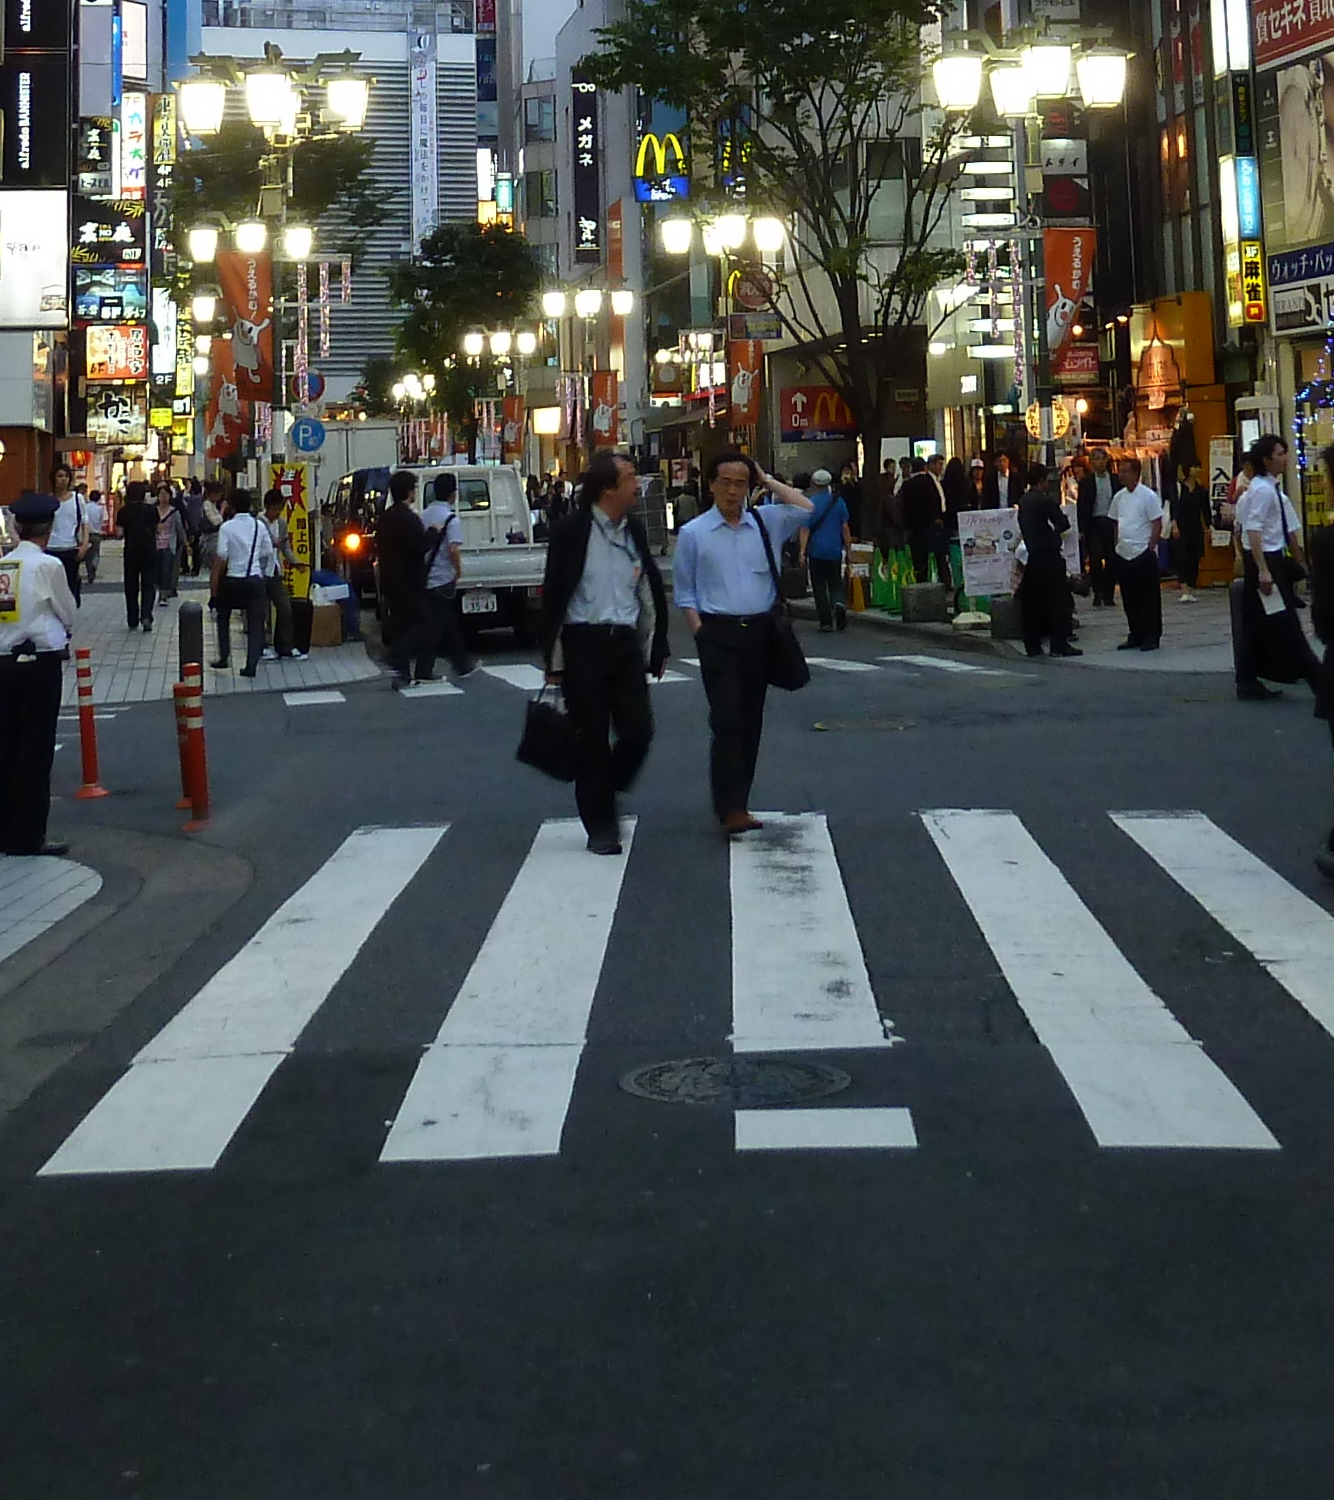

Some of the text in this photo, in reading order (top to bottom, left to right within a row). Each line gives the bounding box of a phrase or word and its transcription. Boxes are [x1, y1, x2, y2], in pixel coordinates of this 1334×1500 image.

[1255, 0, 1306, 46] 質セキネ
[128, 112, 145, 180] カラオケ
[578, 116, 594, 168] メガネ
[1245, 260, 1262, 302] 麻雀
